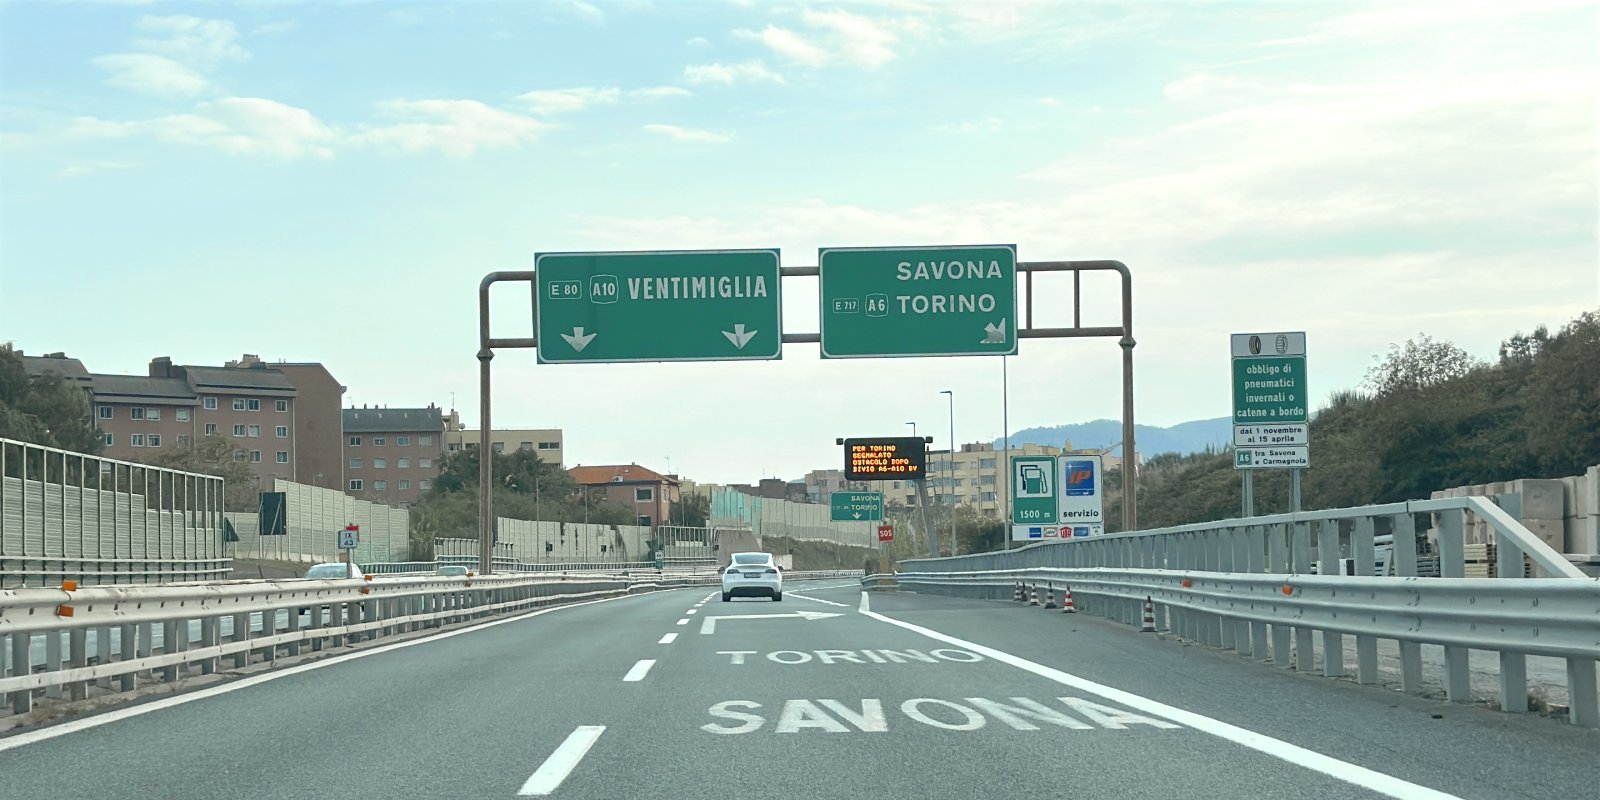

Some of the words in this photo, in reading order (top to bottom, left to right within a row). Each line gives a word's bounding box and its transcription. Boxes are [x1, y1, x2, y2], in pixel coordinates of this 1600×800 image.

[896, 260, 1002, 280] SAVONA
[551, 284, 559, 296] E
[564, 283, 578, 295] 80
[592, 282, 616, 296] A10
[627, 275, 767, 300] VENTIMIGLIA
[835, 301, 842, 310] E
[844, 301, 857, 310] 717
[896, 294, 996, 314] TORINO
[1246, 364, 1280, 375] obbligo
[1283, 363, 1292, 373] di
[1245, 377, 1294, 390] pneumatici
[1245, 392, 1285, 403] invernali
[1288, 394, 1295, 402] o
[1236, 407, 1267, 417] catene
[1279, 406, 1304, 416] bordo
[1271, 435, 1295, 443] aprile
[1070, 470, 1092, 484] IP
[1020, 510, 1040, 519] 1500
[1063, 509, 1099, 518] servizio
[879, 530, 893, 538] SOS
[716, 649, 985, 664] TORINO
[700, 697, 1184, 735] SAVONA
